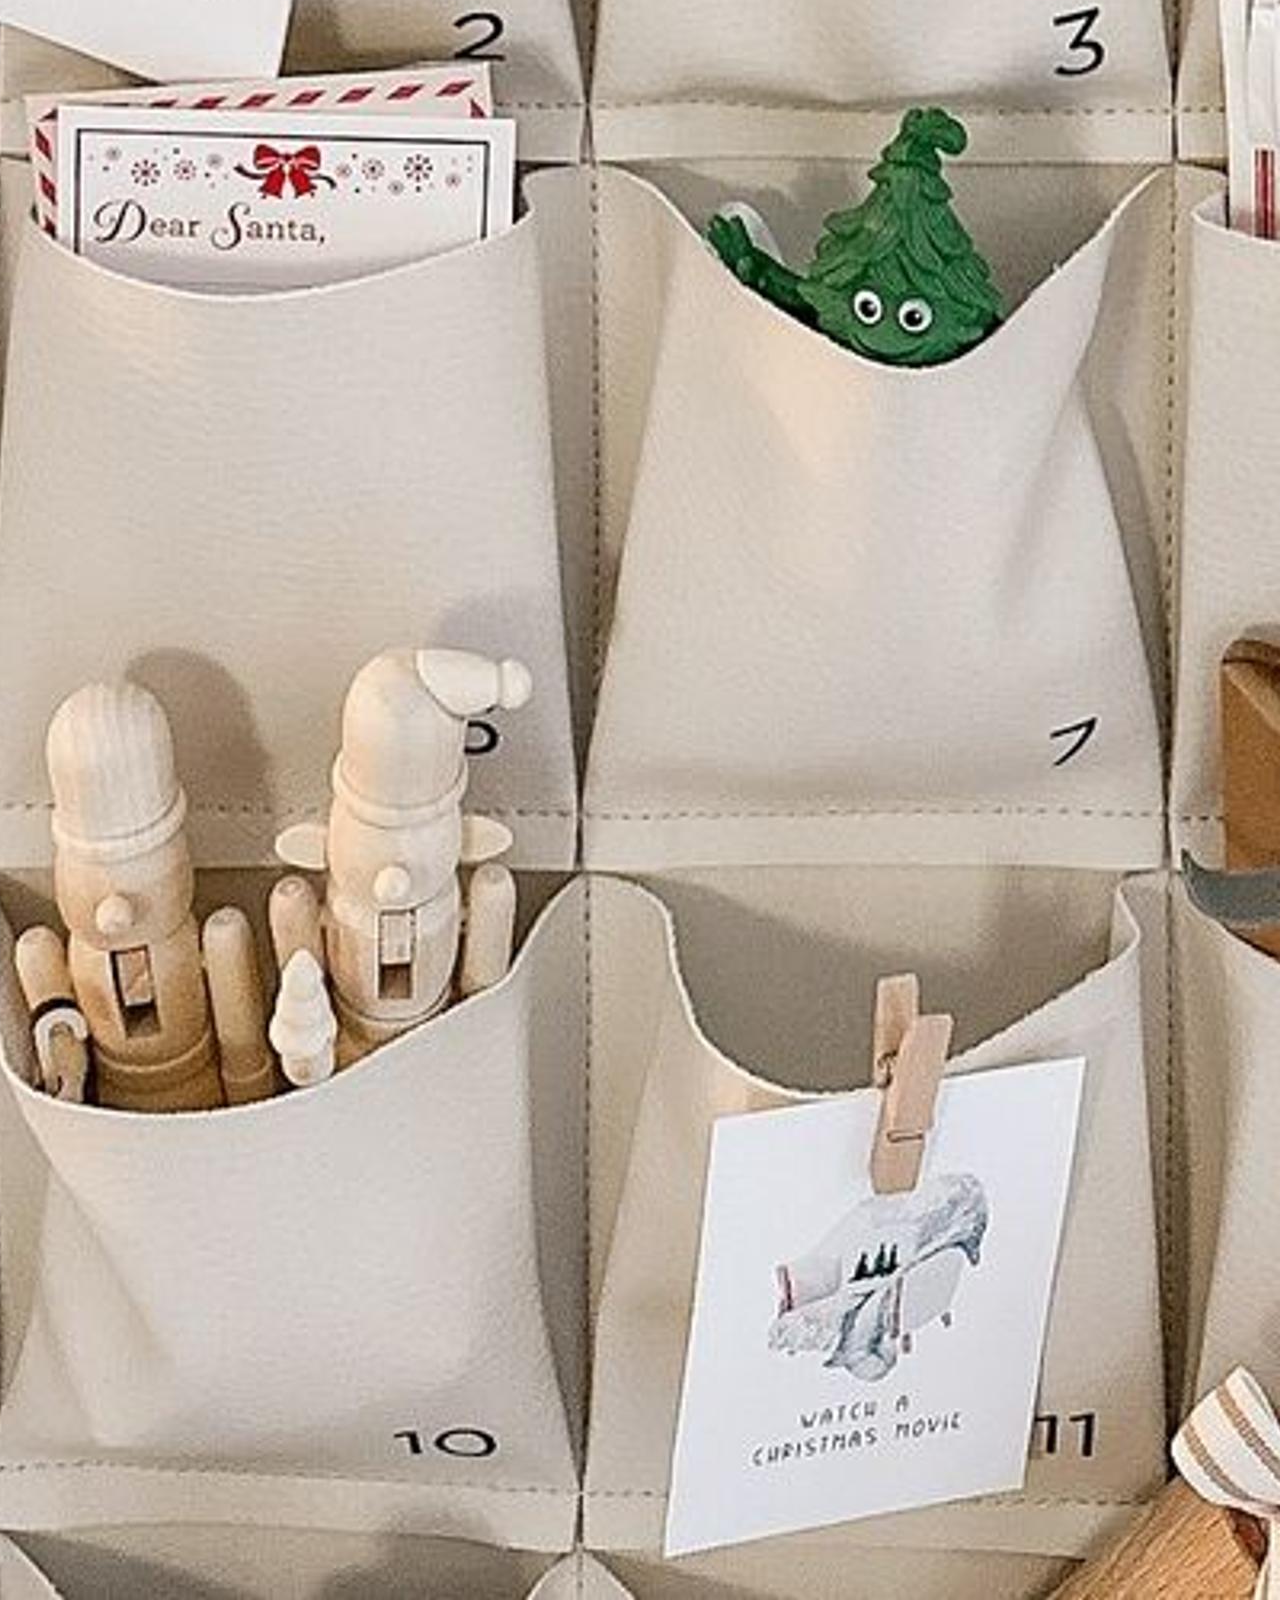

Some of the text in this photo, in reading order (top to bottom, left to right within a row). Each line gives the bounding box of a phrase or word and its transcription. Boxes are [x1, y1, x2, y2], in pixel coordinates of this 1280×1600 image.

[453, 12, 504, 60] 2
[1052, 6, 1105, 75] 3
[93, 199, 326, 251] Dear Santa,
[1049, 716, 1098, 767] 7
[800, 1395, 909, 1428] WATCH A
[1035, 1413, 1093, 1457] 11
[393, 1428, 497, 1458] 10
[752, 1412, 961, 1466] CHRISTMAS MOVIE
